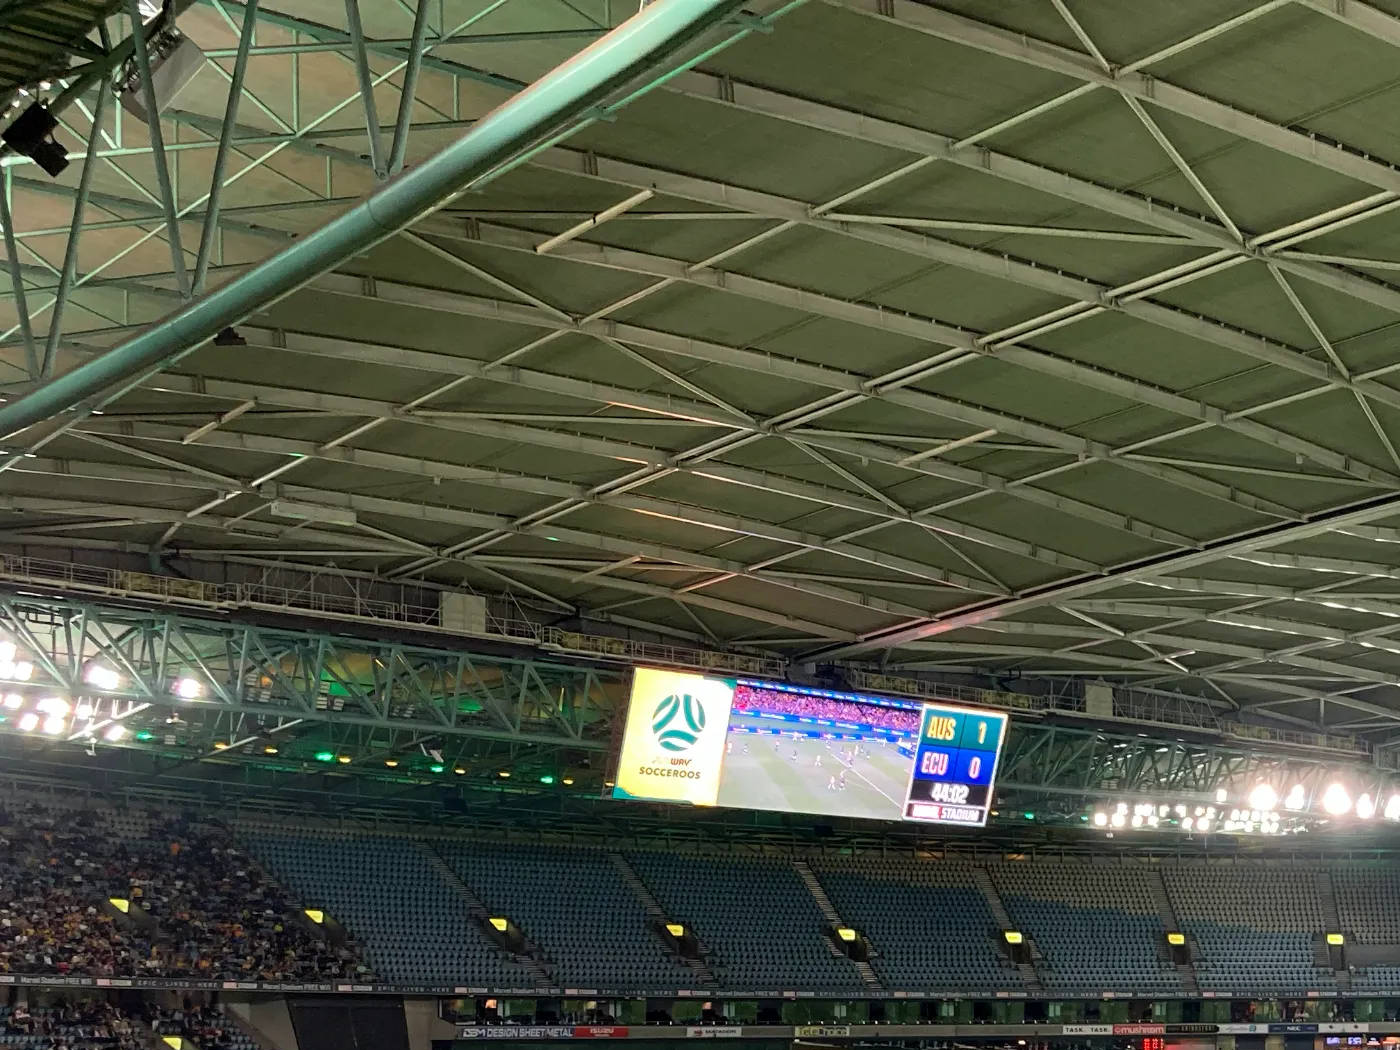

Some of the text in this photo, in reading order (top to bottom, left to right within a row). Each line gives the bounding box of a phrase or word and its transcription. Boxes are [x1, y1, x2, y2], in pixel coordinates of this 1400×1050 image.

[927, 716, 956, 740] AUS
[978, 721, 987, 744] 1
[639, 766, 701, 779] SOCCEROOS
[921, 751, 949, 776] ECU
[968, 756, 981, 779] 0
[931, 783, 969, 804] 44:02
[941, 807, 980, 821] STADIUM
[487, 1028, 518, 1038] DESIGN
[519, 1028, 545, 1038] SHEET
[547, 1028, 573, 1037] METAL
[1121, 1024, 1164, 1034] mushroom
